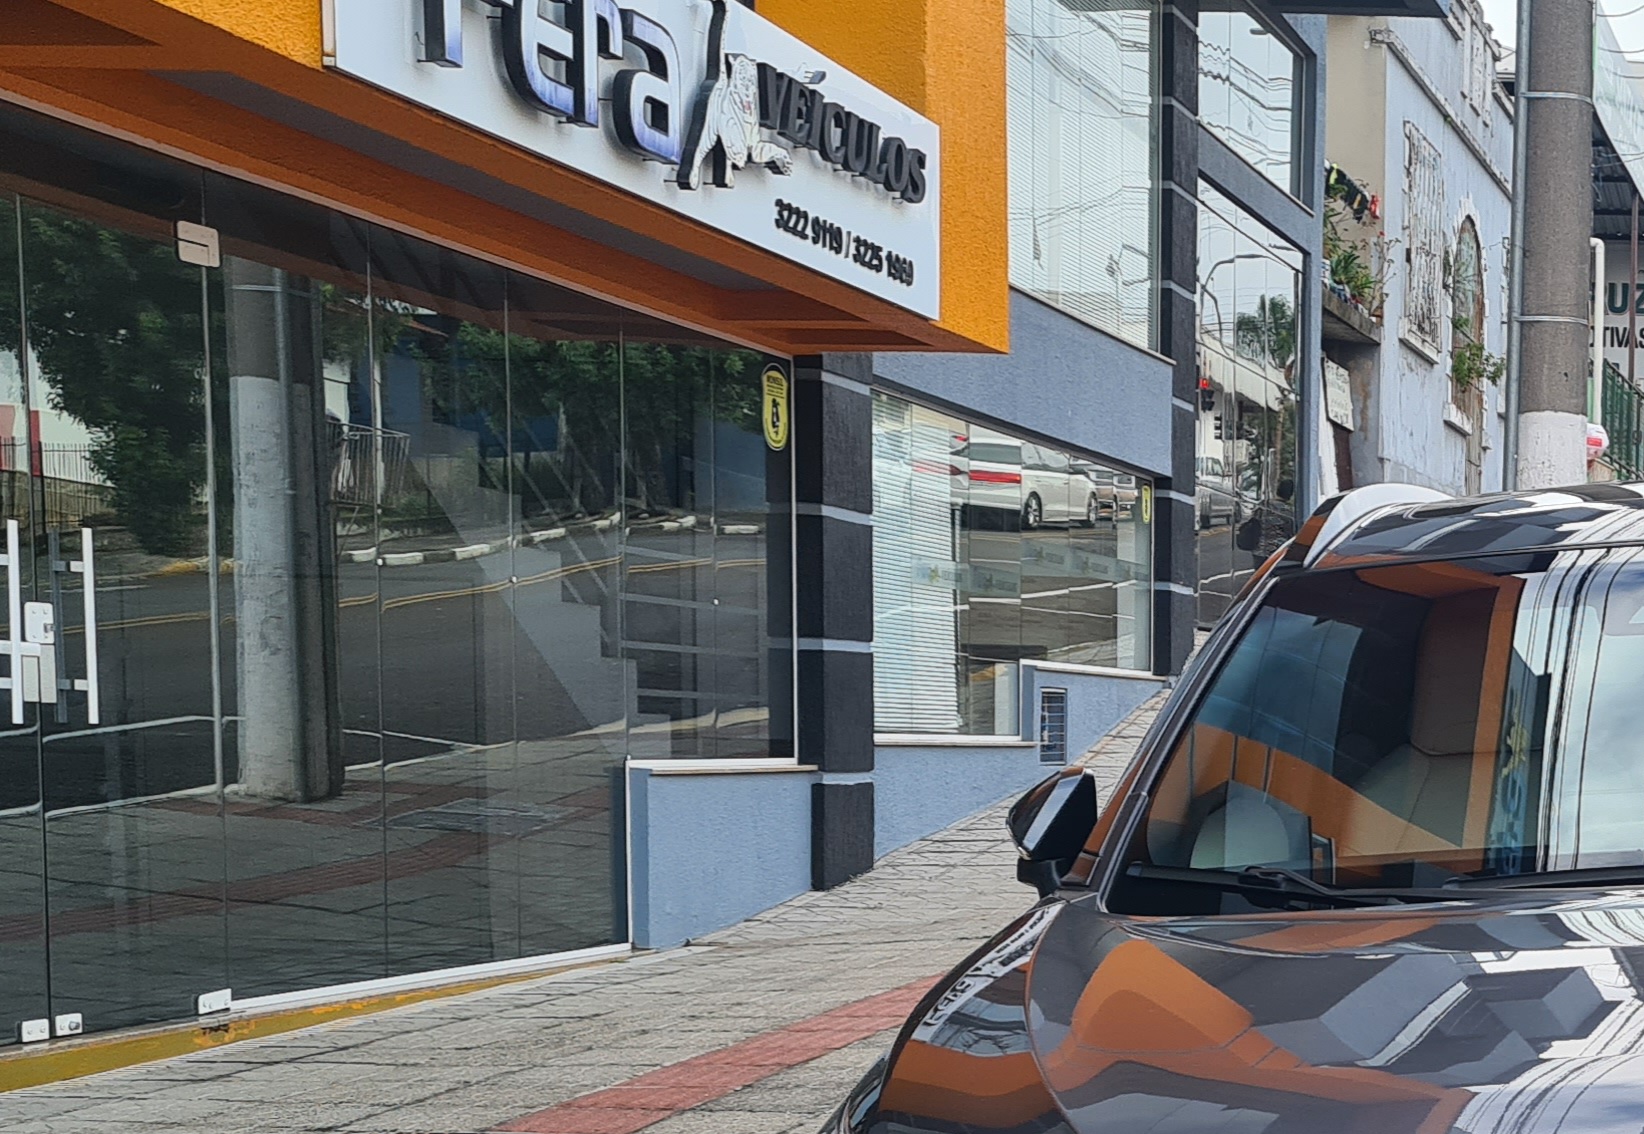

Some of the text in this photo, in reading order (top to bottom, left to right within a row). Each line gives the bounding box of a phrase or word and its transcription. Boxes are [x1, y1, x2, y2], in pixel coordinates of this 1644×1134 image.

[757, 62, 927, 203] VEÍCULOS
[774, 198, 809, 240] 3222
[811, 216, 843, 255] 9119
[852, 235, 883, 273] 3225
